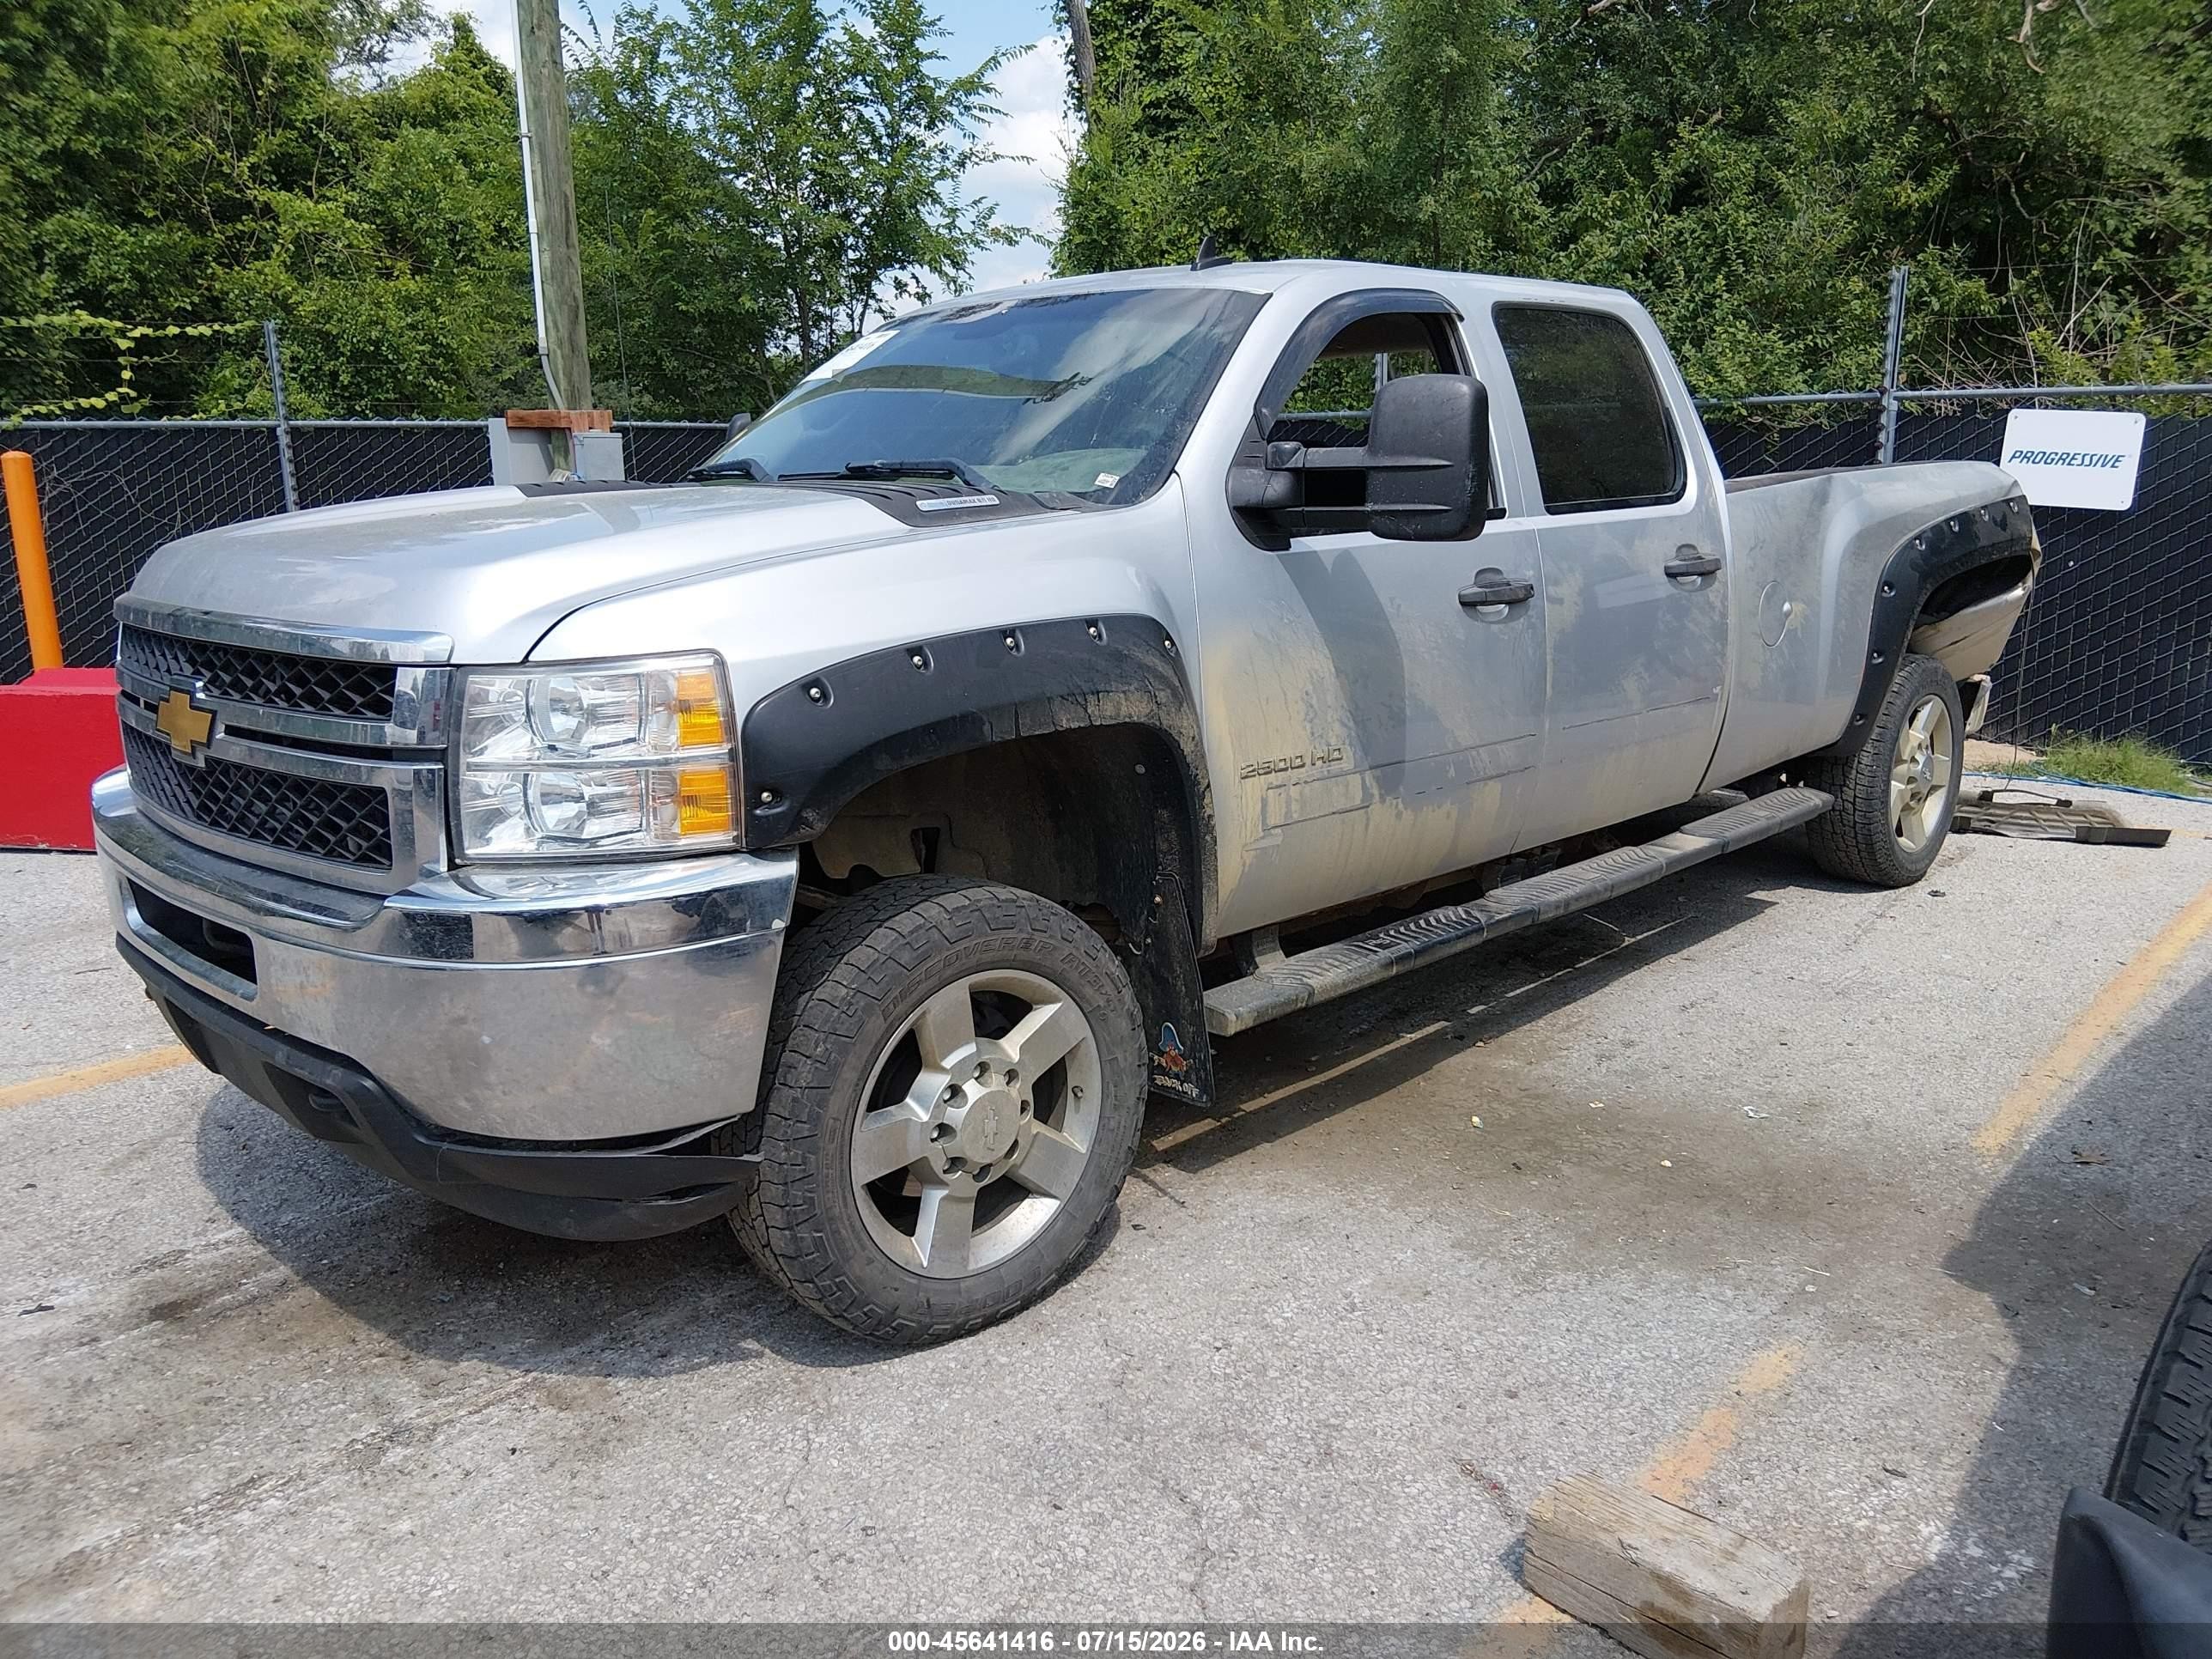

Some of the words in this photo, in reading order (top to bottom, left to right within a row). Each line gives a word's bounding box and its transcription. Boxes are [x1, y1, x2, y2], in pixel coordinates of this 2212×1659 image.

[2007, 449, 2126, 469] PROGRESSIVE
[1240, 754, 1306, 780] 2500
[1310, 747, 1344, 766] HD
[880, 936, 1054, 1023] DISCOVERER
